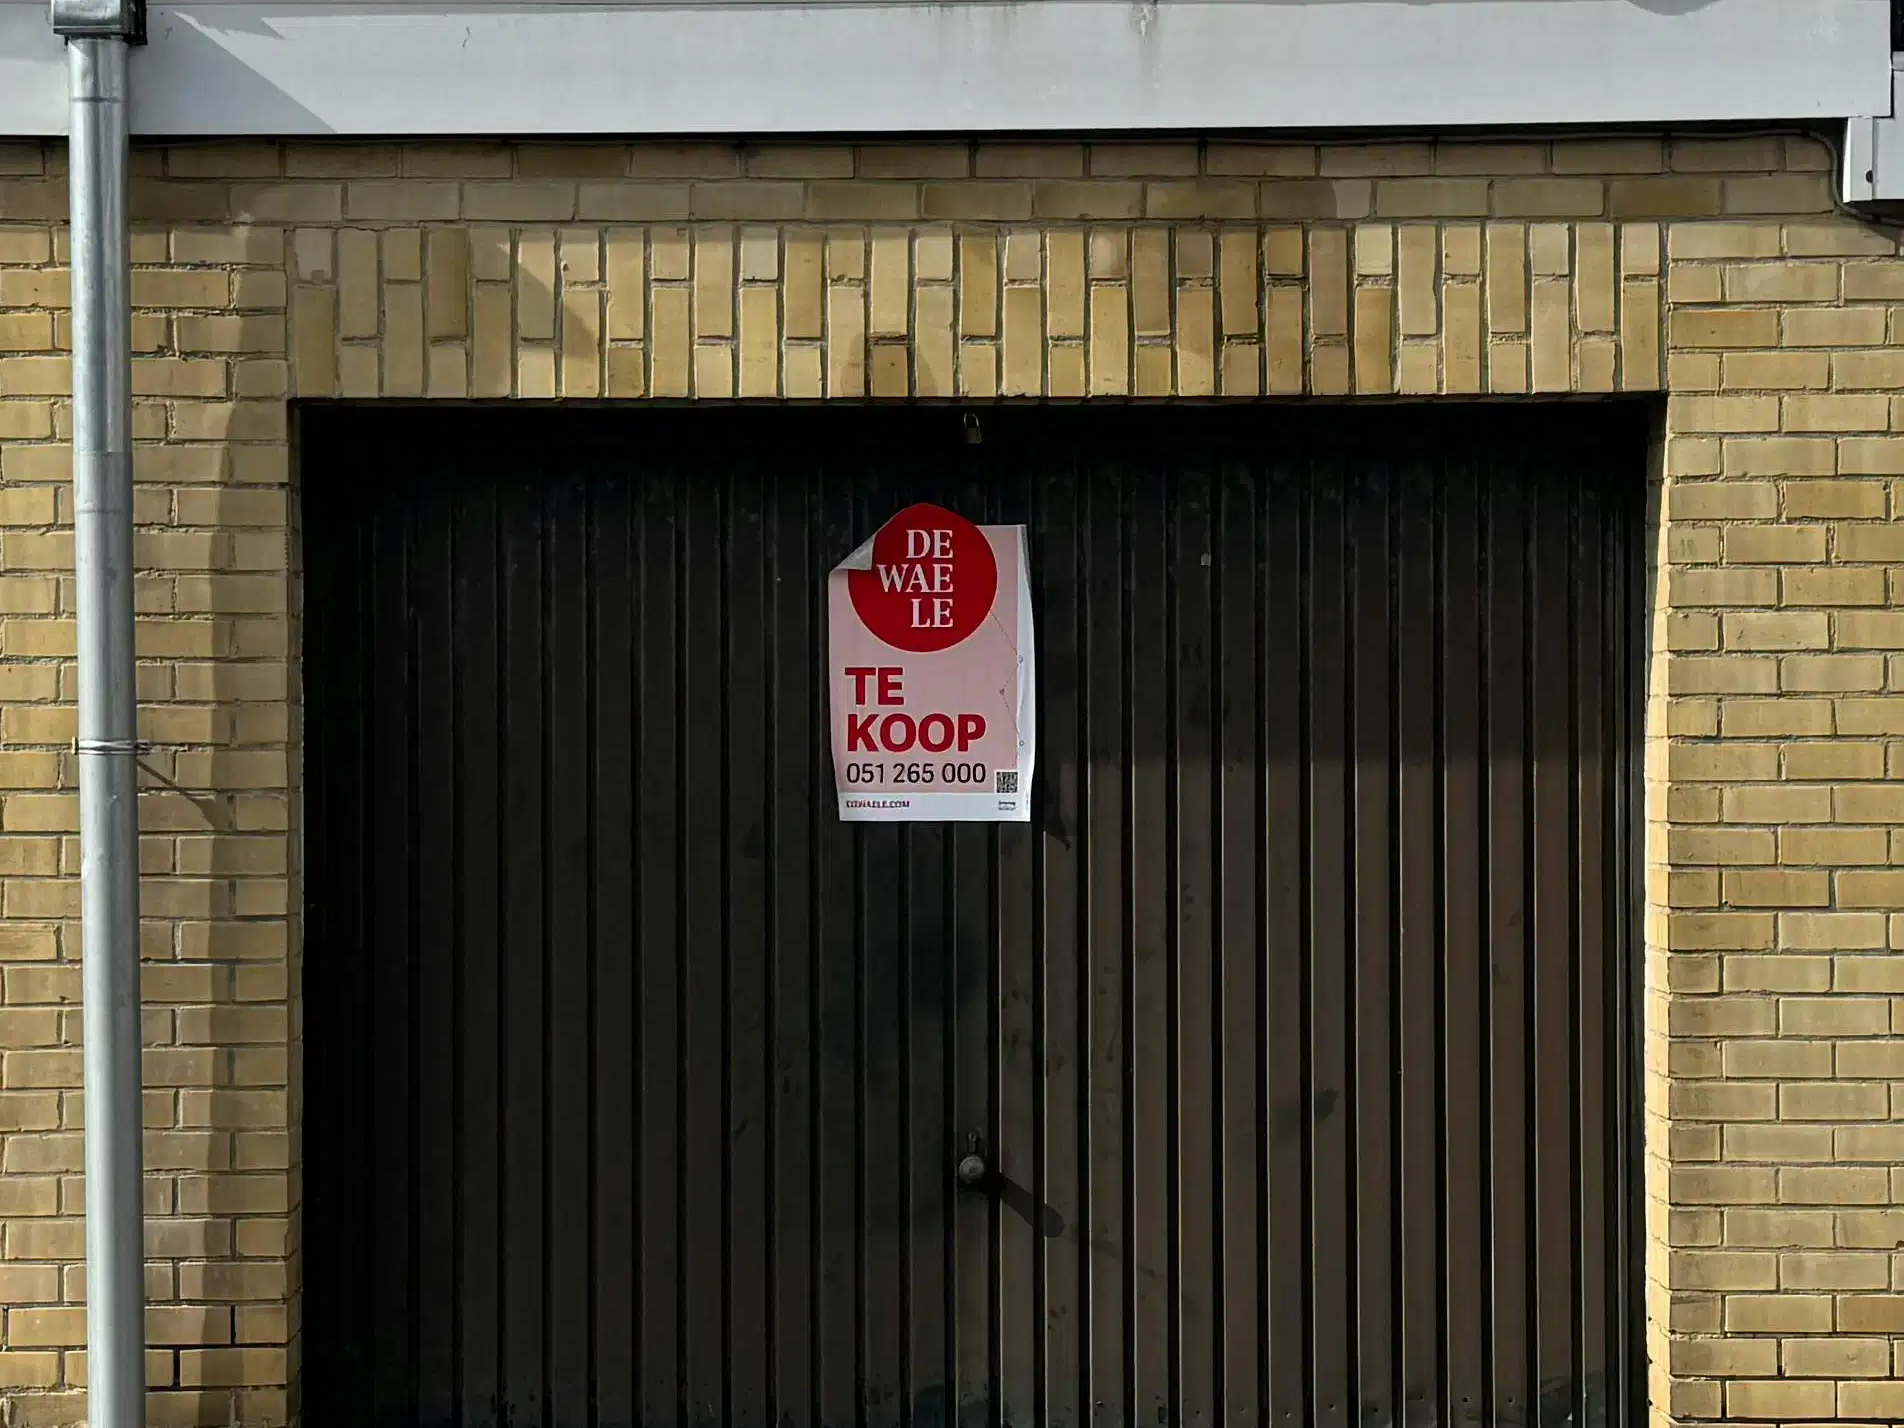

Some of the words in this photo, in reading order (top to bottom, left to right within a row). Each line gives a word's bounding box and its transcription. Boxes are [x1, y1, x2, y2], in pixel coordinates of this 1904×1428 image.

[906, 529, 954, 559] DE
[876, 563, 954, 593] WAE
[910, 598, 954, 628] LE
[844, 667, 905, 705] TE
[847, 713, 987, 752] KOOP
[846, 762, 884, 783] 051
[893, 762, 934, 783] 265
[942, 762, 986, 783] 000
